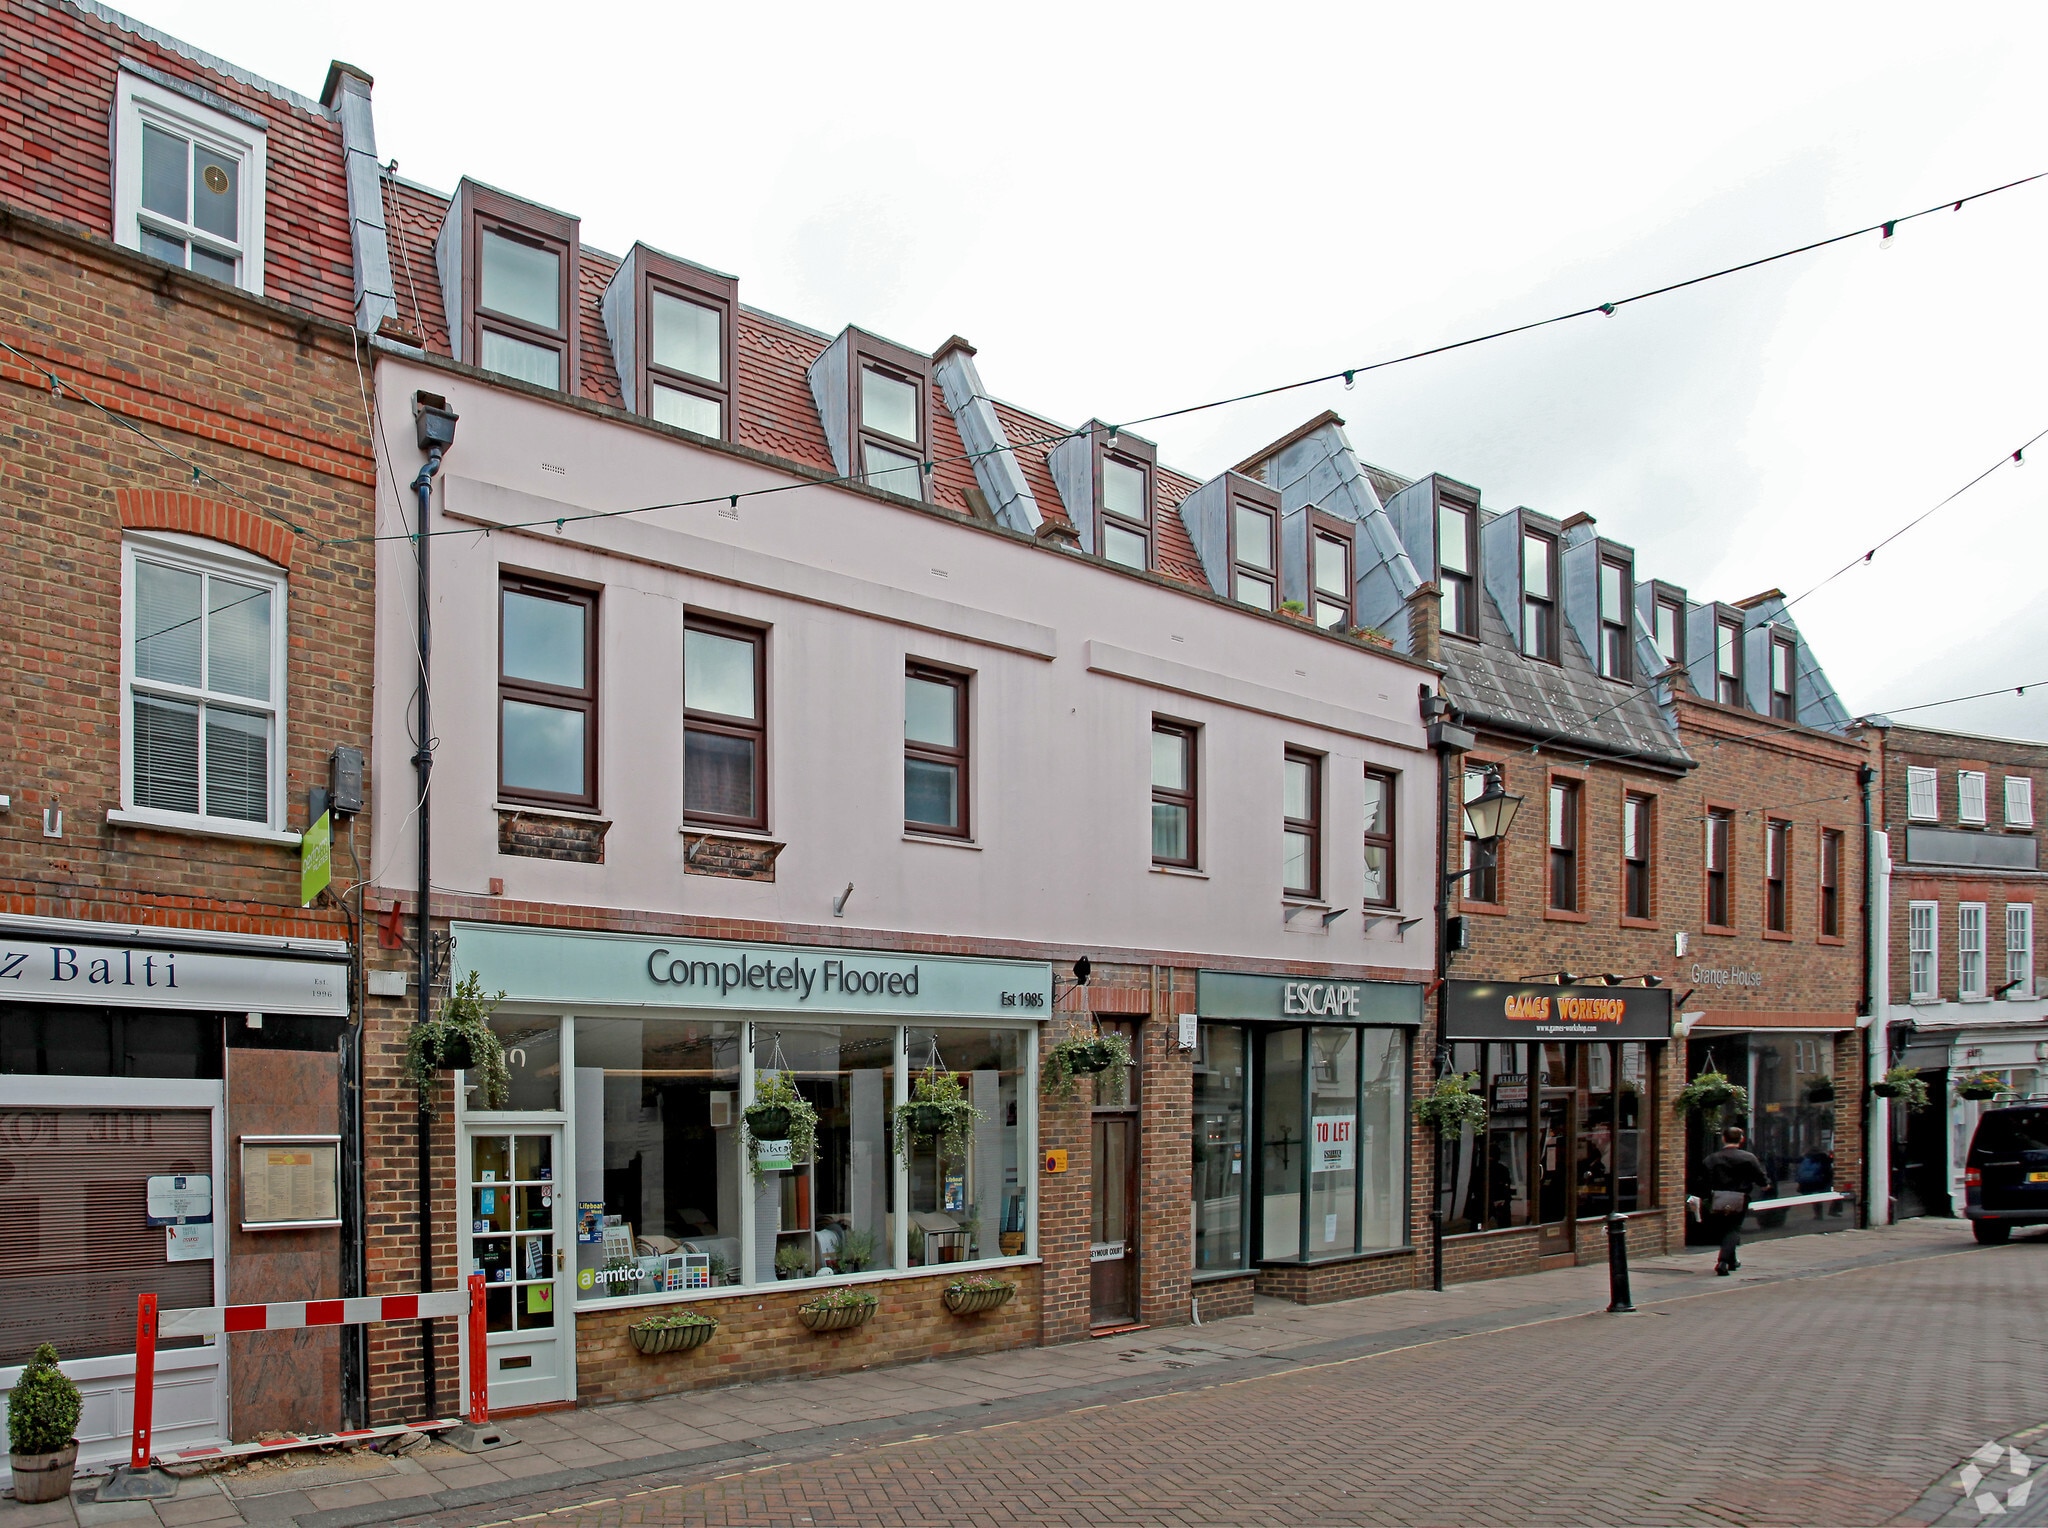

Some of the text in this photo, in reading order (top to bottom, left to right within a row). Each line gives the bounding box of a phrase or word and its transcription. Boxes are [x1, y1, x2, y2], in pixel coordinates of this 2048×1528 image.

[50, 946, 179, 988] Balti
[648, 949, 918, 1000] Completely Floored
[1691, 963, 1762, 989] Grange House
[1001, 991, 1044, 1007] Est 1985
[1284, 982, 1361, 1017] ESCAPE
[1504, 994, 1627, 1025] GAMES WORKSHOP
[1536, 1024, 1597, 1034] www.games-workshop.com
[1317, 1121, 1350, 1142] TO LET
[579, 1202, 603, 1210] Lifeboat
[1109, 1246, 1123, 1256] COURT
[595, 1265, 645, 1284] amtico
